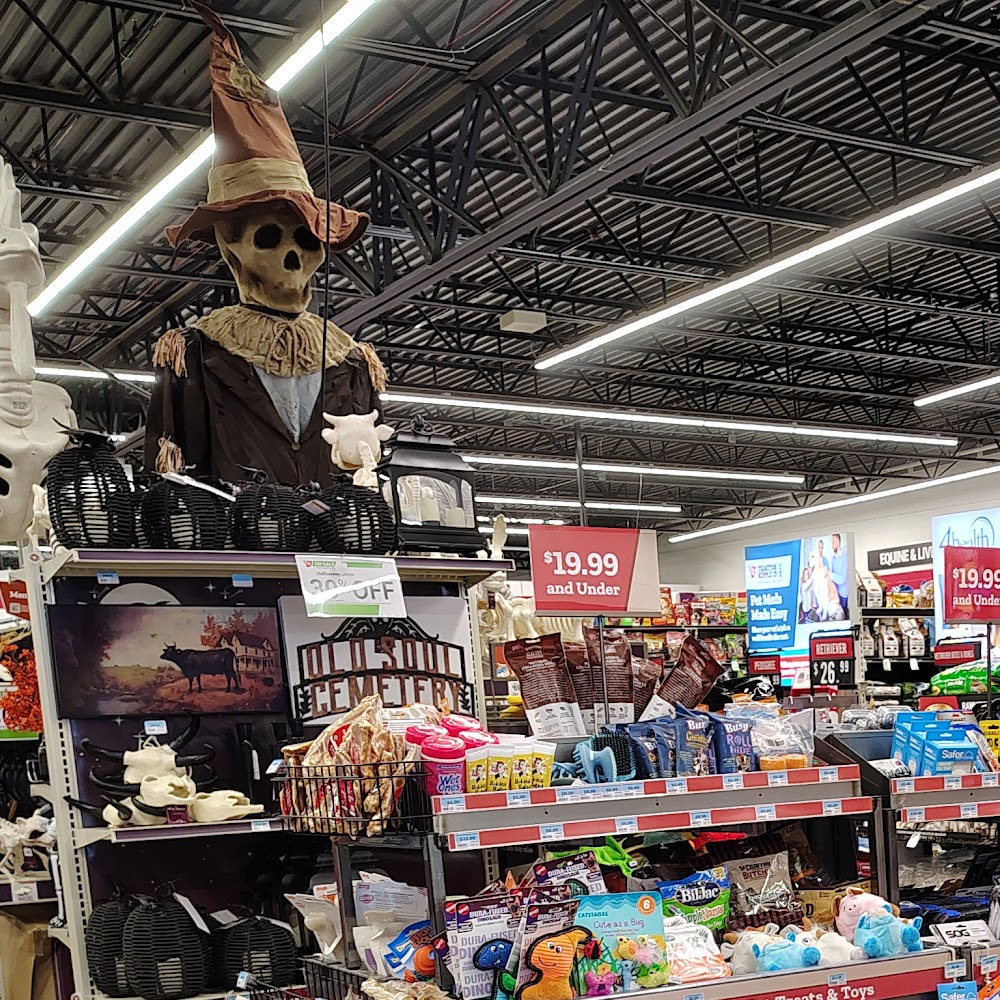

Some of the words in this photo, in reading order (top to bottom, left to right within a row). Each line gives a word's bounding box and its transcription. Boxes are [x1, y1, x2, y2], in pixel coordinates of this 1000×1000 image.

[880, 549, 909, 566] EQUINE
[910, 548, 917, 561] &
[544, 551, 619, 576] $19.99
[353, 580, 394, 599] OFF
[547, 582, 573, 595] and
[576, 582, 620, 596] Under
[953, 594, 973, 606] and
[816, 643, 847, 655] RETRIEVER
[306, 637, 367, 679] OLD
[380, 636, 462, 677] SOUL
[310, 674, 463, 718] CEMETERY
[942, 750, 964, 759] Safer
[440, 775, 460, 785] Wet
[438, 782, 461, 792] Ones
[642, 900, 651, 910] 6
[594, 920, 611, 929] Cute
[630, 918, 645, 929] Bug
[945, 929, 970, 938] SOG
[826, 988, 839, 1000] &
[840, 984, 875, 1000] Toys
